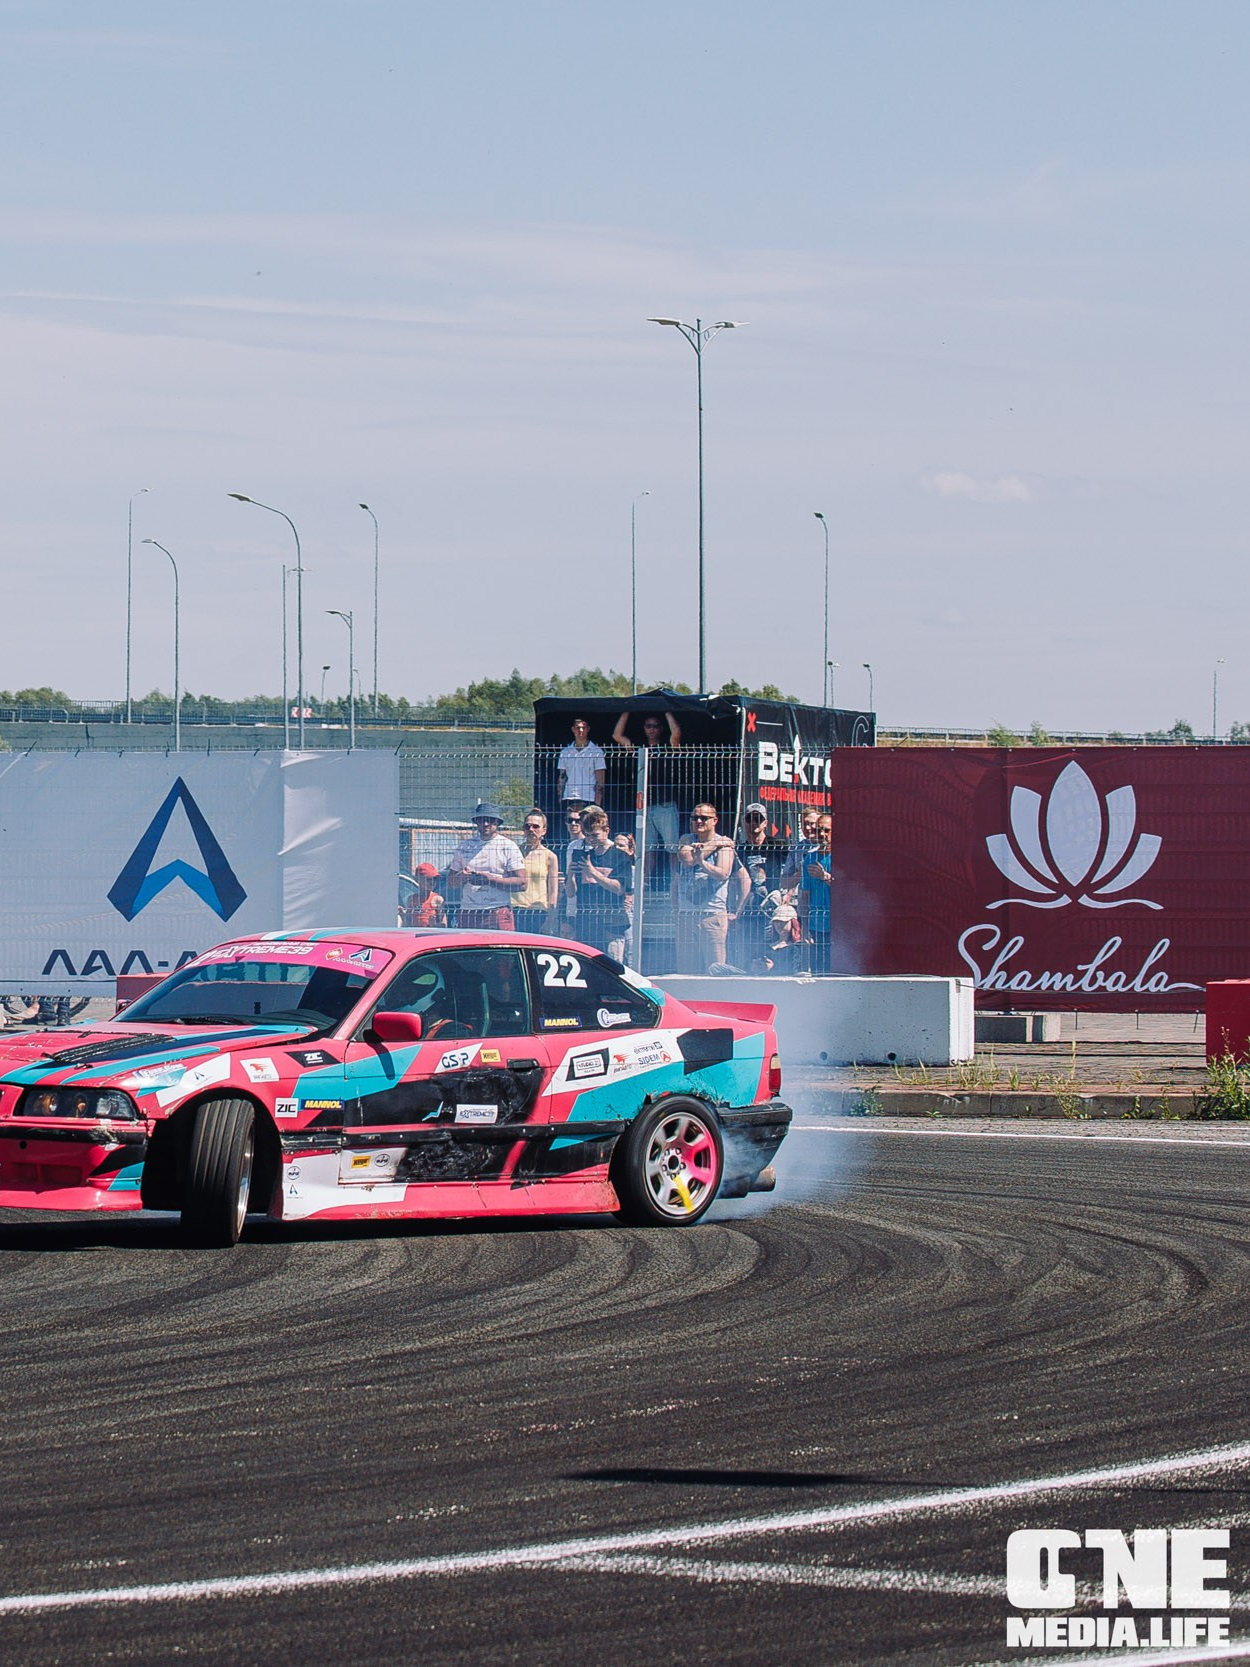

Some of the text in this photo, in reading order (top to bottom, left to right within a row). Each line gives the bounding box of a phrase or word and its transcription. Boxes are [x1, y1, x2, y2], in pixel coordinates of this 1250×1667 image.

[958, 924, 1205, 992] Shambala
[537, 953, 588, 988] 22
[544, 1018, 579, 1027] MANNOL
[304, 1052, 323, 1061] ZIC
[638, 1054, 660, 1065] SIDEM
[277, 1103, 296, 1114] ZIC
[305, 1099, 342, 1109] MANNOL
